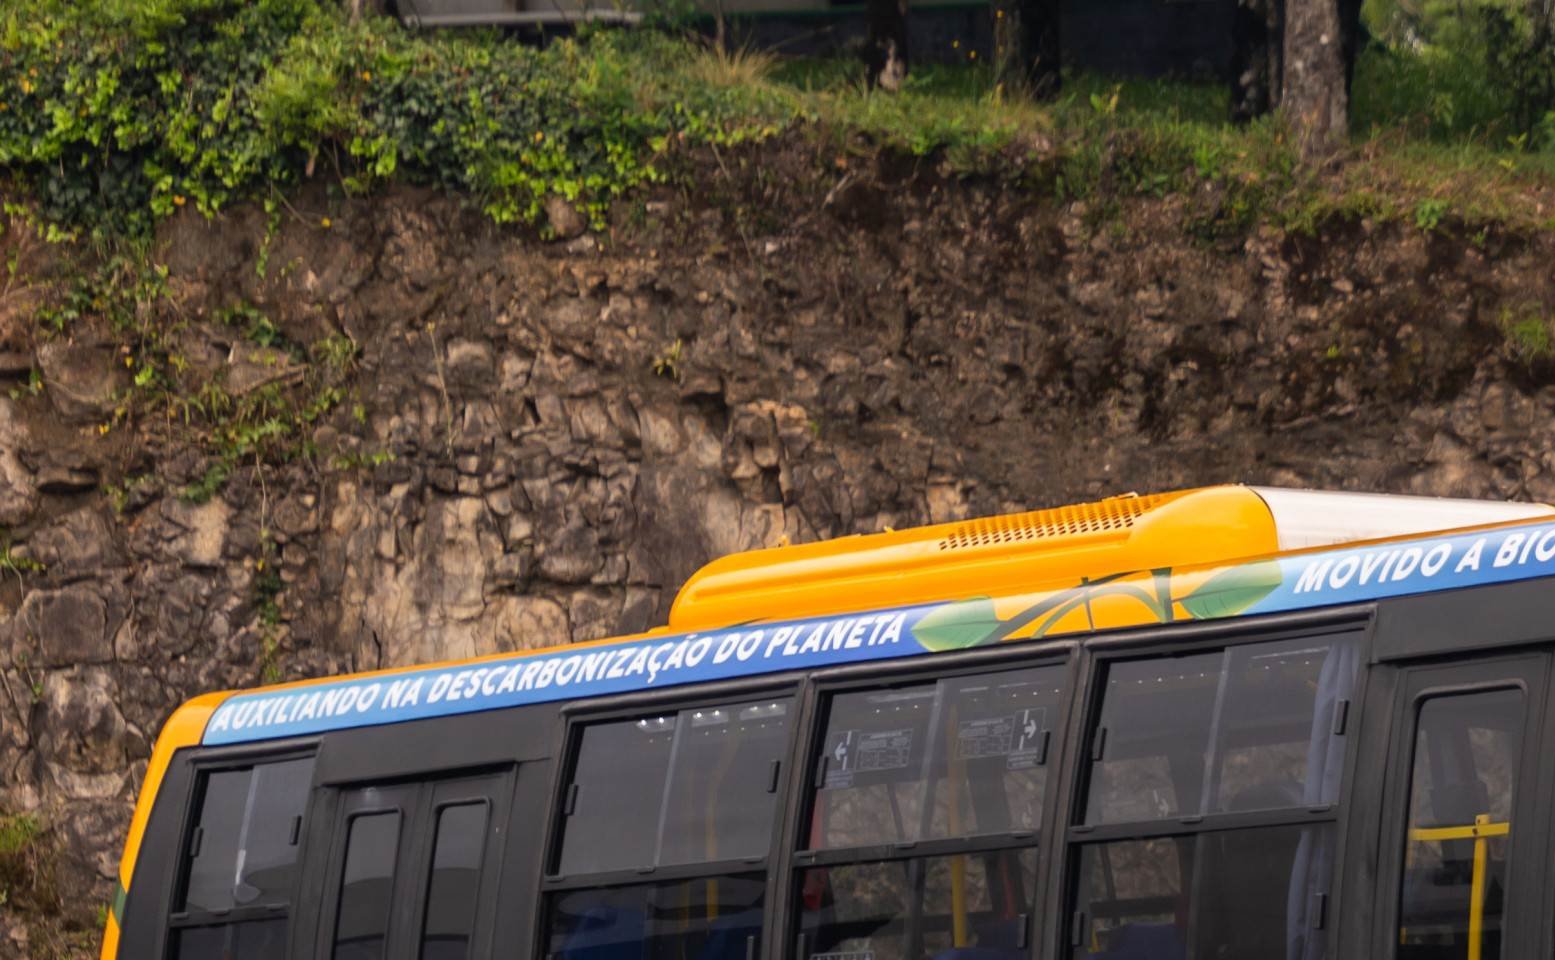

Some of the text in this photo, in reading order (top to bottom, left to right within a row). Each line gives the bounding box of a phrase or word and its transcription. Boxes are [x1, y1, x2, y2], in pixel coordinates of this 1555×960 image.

[1293, 543, 1453, 595] MOVIDO
[1455, 537, 1488, 574] A
[211, 612, 907, 733] AUXILIANDO NA DESCARBONIZAÇÃO DO PLANETA
